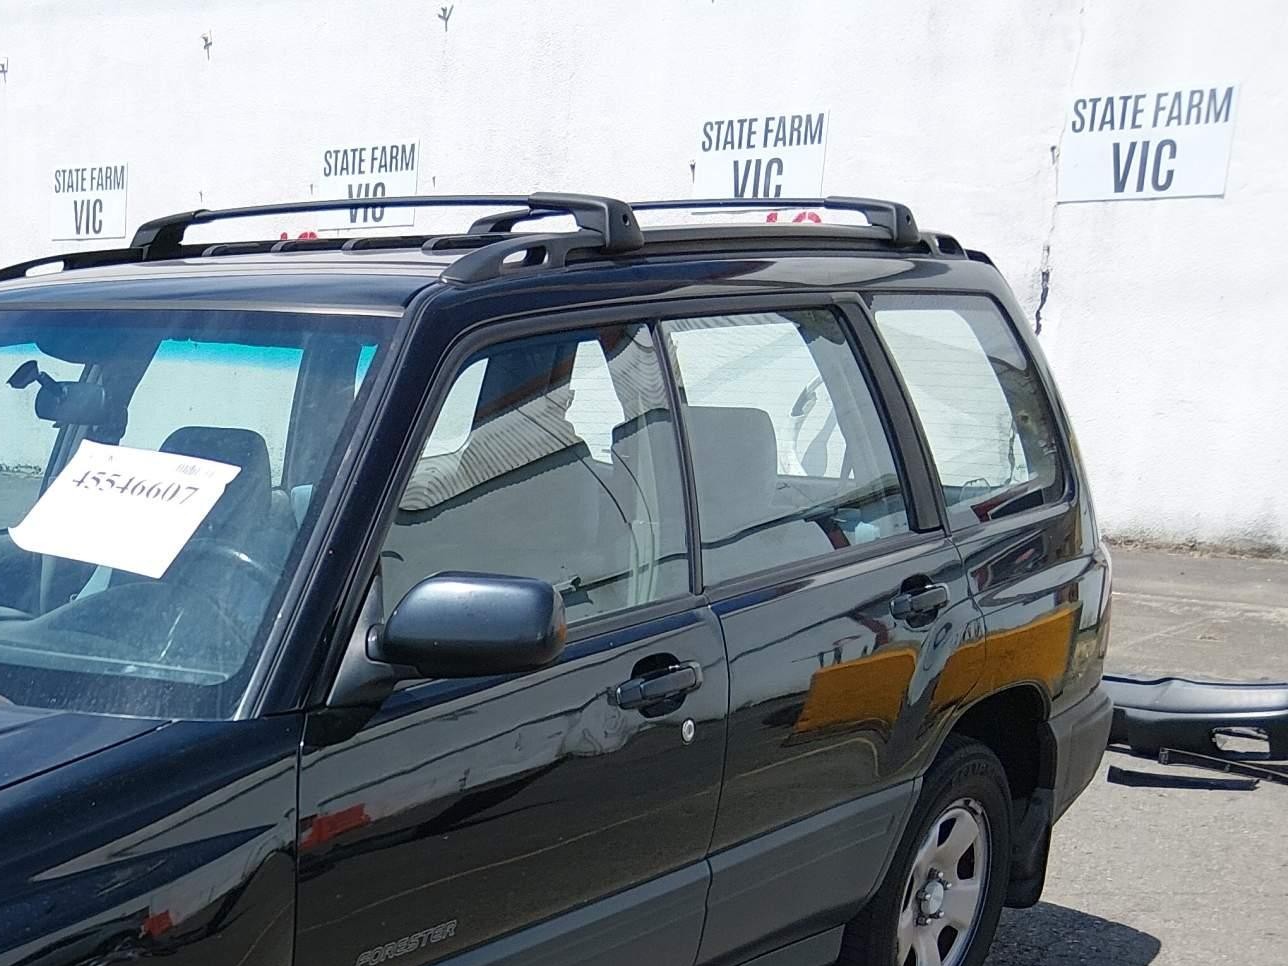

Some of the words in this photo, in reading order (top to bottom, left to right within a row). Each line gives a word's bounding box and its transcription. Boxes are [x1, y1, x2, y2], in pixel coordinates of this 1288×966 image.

[1071, 93, 1147, 133] STATE
[1151, 86, 1235, 129] FARM
[701, 117, 759, 152] STATE
[762, 112, 825, 148] FARM
[54, 168, 87, 193] STATE
[89, 165, 125, 191] FARM
[323, 147, 367, 177] STATE
[370, 143, 416, 174] FARM
[732, 157, 784, 199] VIC
[1112, 138, 1177, 194] VIC
[73, 198, 103, 235] VIC
[72, 469, 200, 505] 45546607
